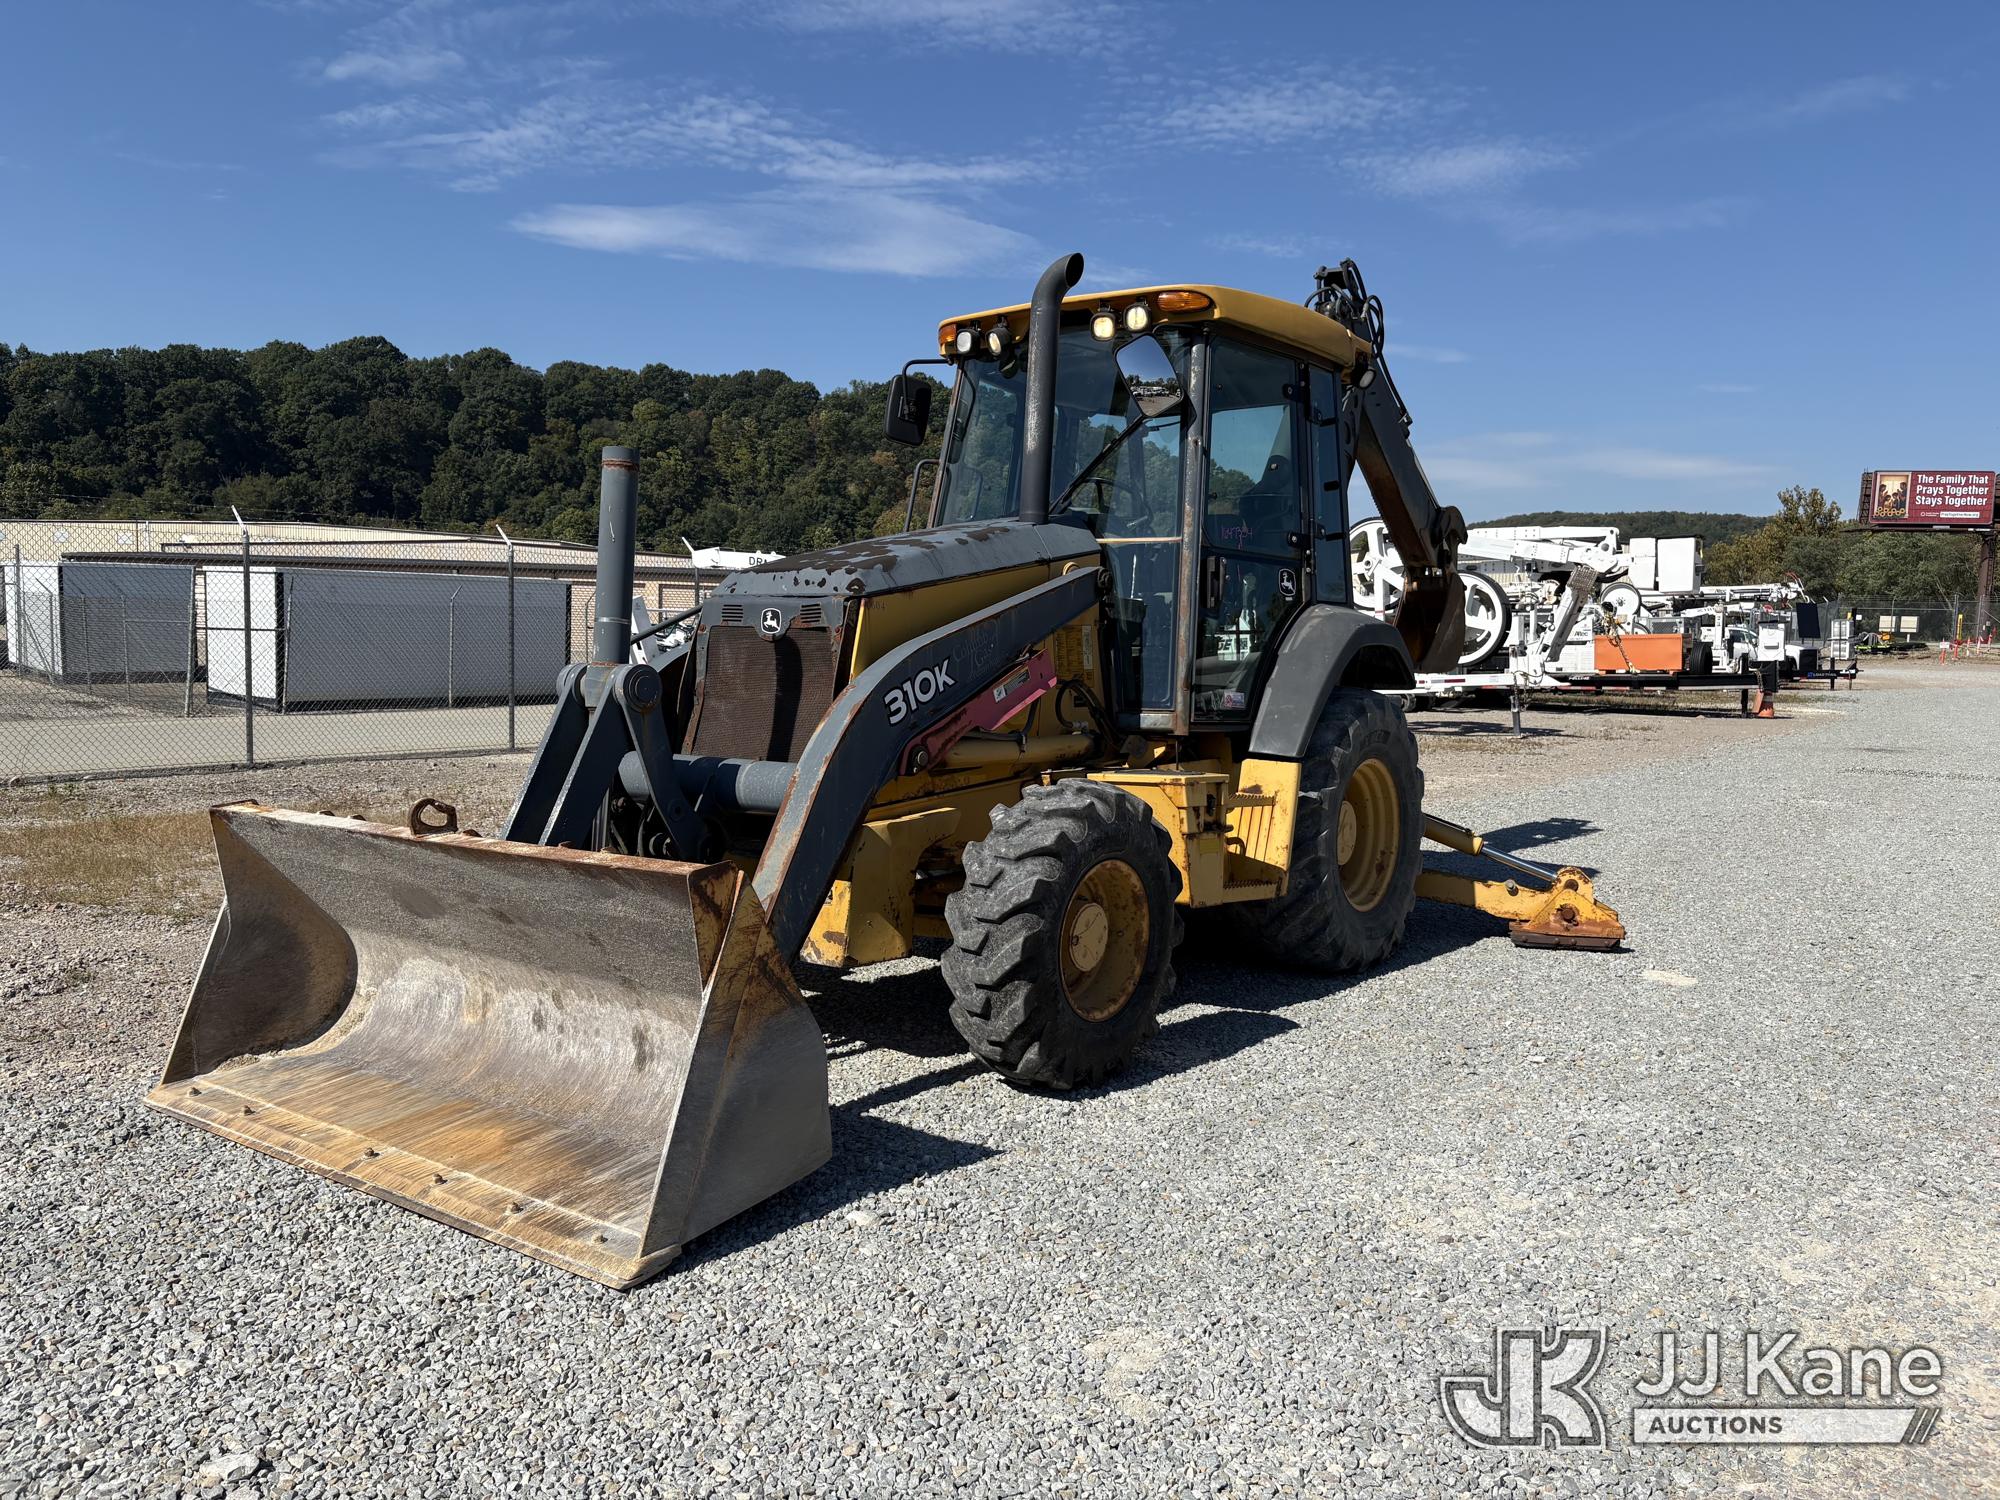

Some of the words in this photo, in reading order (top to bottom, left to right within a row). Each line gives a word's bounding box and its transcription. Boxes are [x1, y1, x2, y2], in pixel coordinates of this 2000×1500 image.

[1917, 475, 1933, 484] The
[1936, 475, 1966, 486] Family
[1968, 475, 1989, 484] That
[1916, 485, 1944, 496] Prays
[1946, 485, 1989, 496] Together
[1915, 496, 1942, 507] Stays
[1944, 496, 1987, 507] Together
[883, 658, 957, 726] 310K
